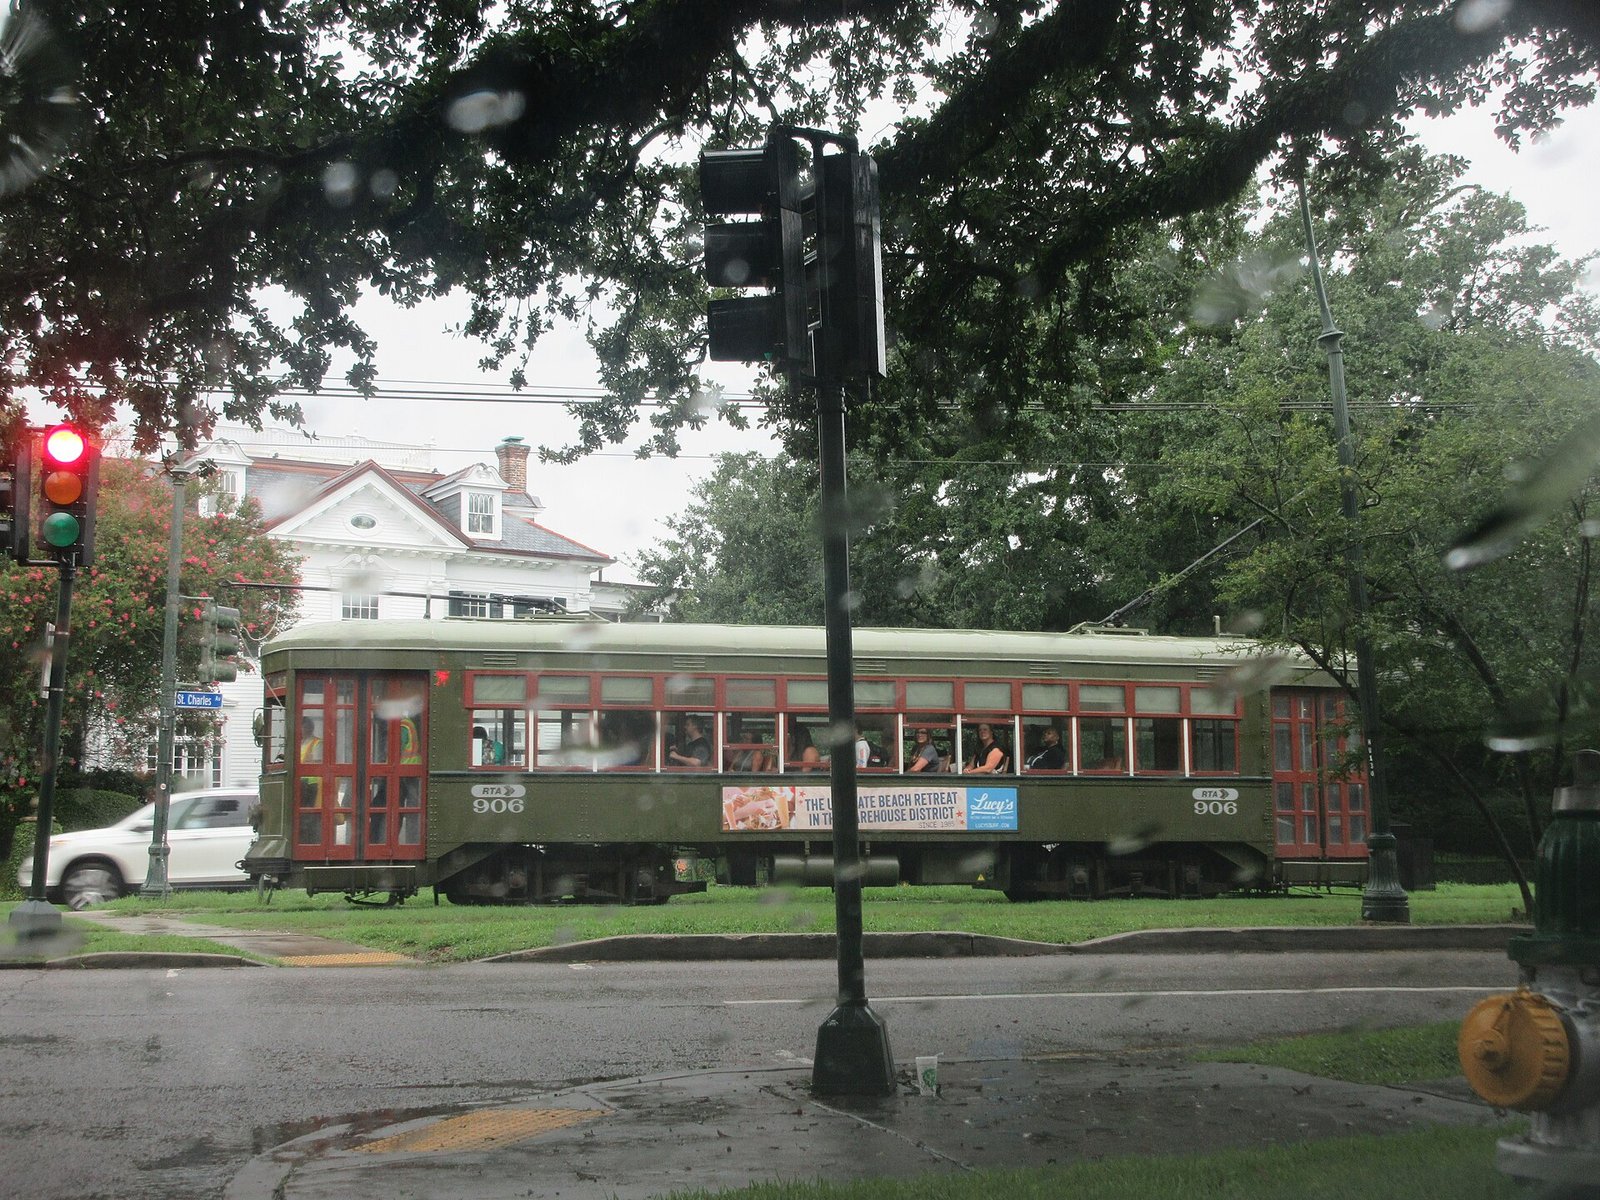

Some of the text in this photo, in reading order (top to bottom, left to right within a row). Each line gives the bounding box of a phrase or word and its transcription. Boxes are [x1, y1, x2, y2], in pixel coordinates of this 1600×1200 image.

[187, 694, 212, 706] Charles
[1201, 790, 1218, 798] RTA
[473, 799, 524, 813] 906
[805, 798, 825, 811] THE
[878, 794, 911, 808] BEACH
[914, 792, 957, 806] RETREAT
[970, 793, 1014, 815] Lucy's
[1193, 801, 1238, 815] 906
[809, 813, 820, 826] IN
[858, 809, 907, 823] REHOUSE
[909, 806, 954, 821] DISTRICT
